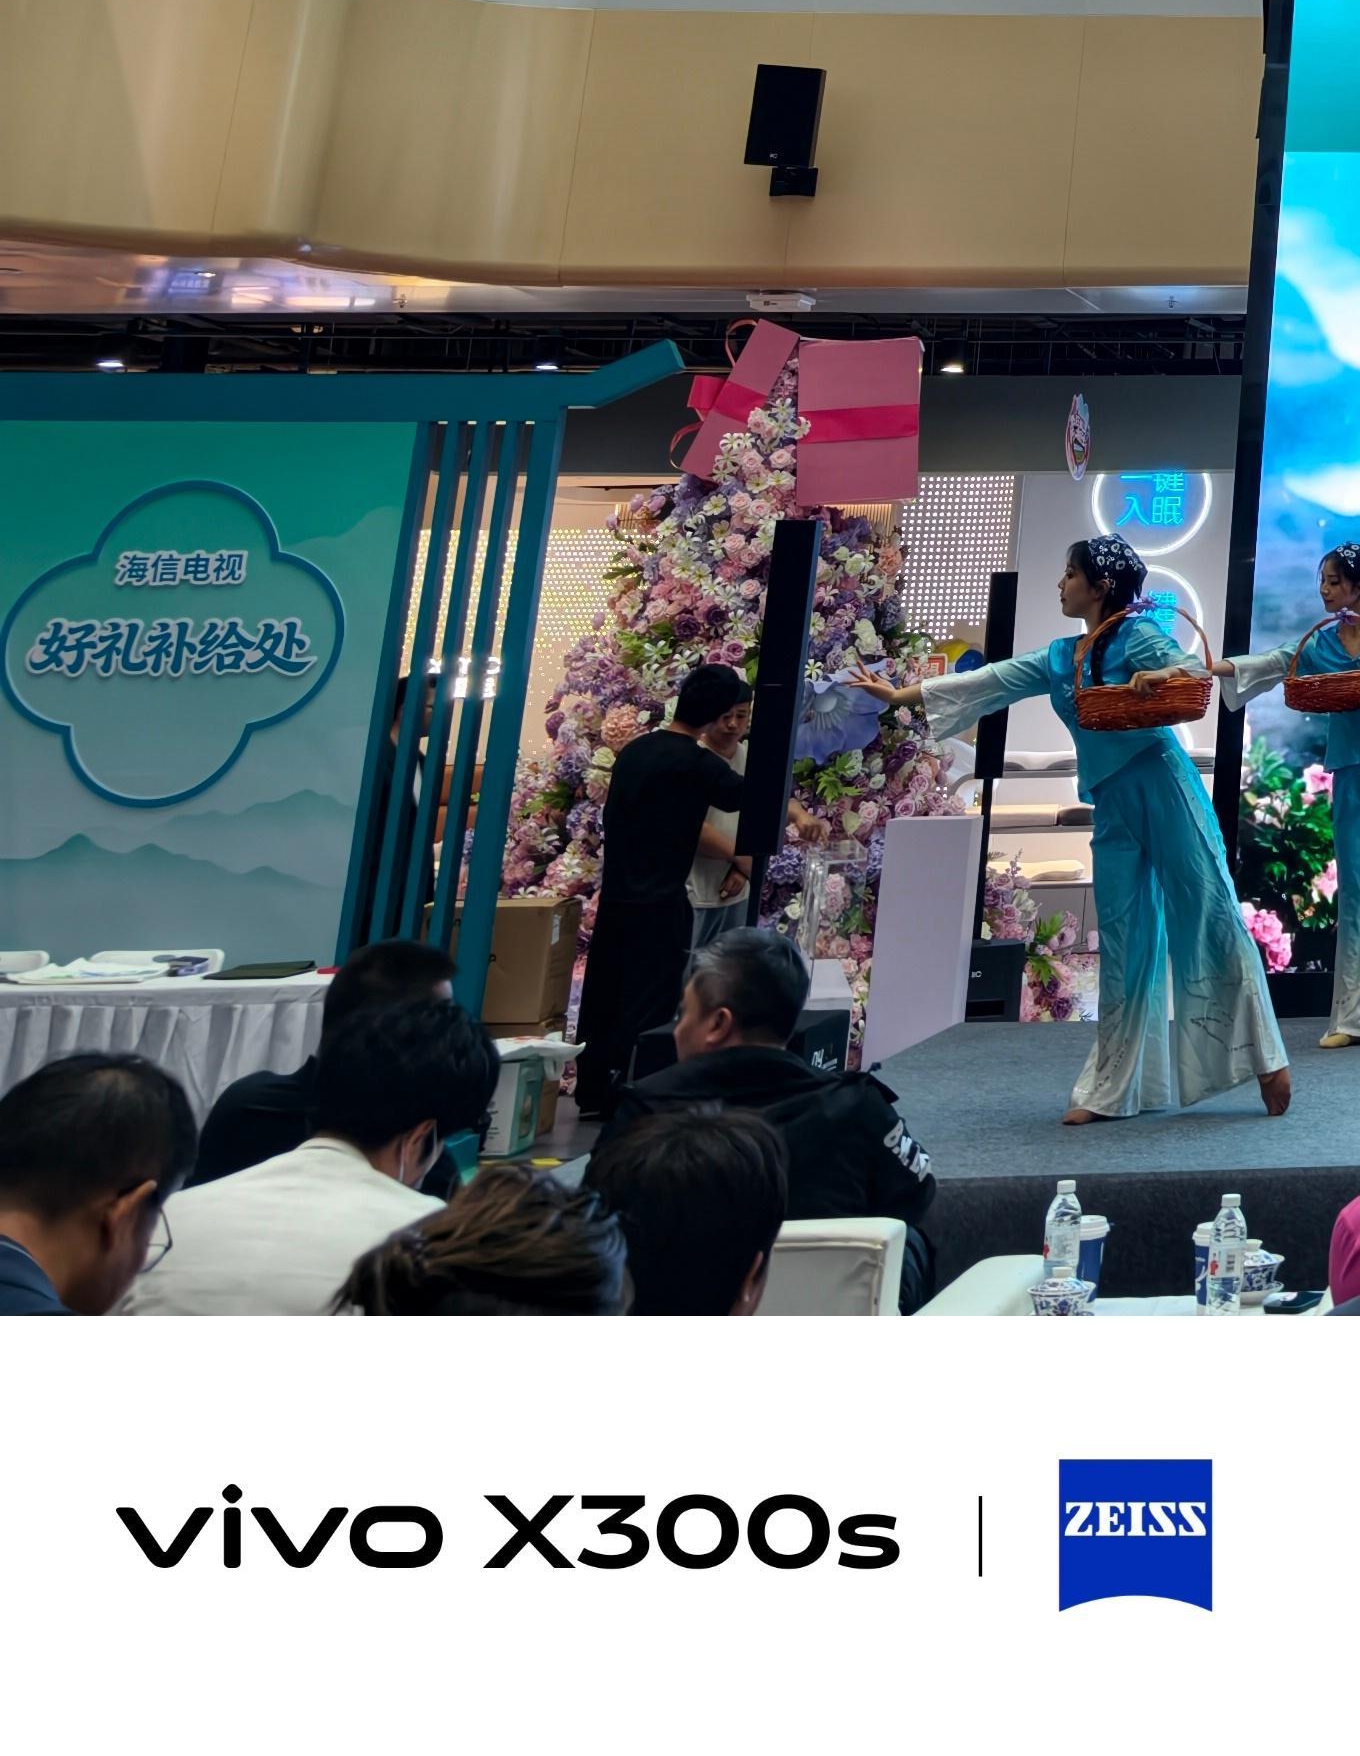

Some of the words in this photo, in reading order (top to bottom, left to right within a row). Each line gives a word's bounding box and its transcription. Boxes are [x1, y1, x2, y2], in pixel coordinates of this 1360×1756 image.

[1115, 496, 1186, 528] 入眠
[115, 549, 246, 586] 海信电视
[27, 617, 318, 676] 好礼补给处
